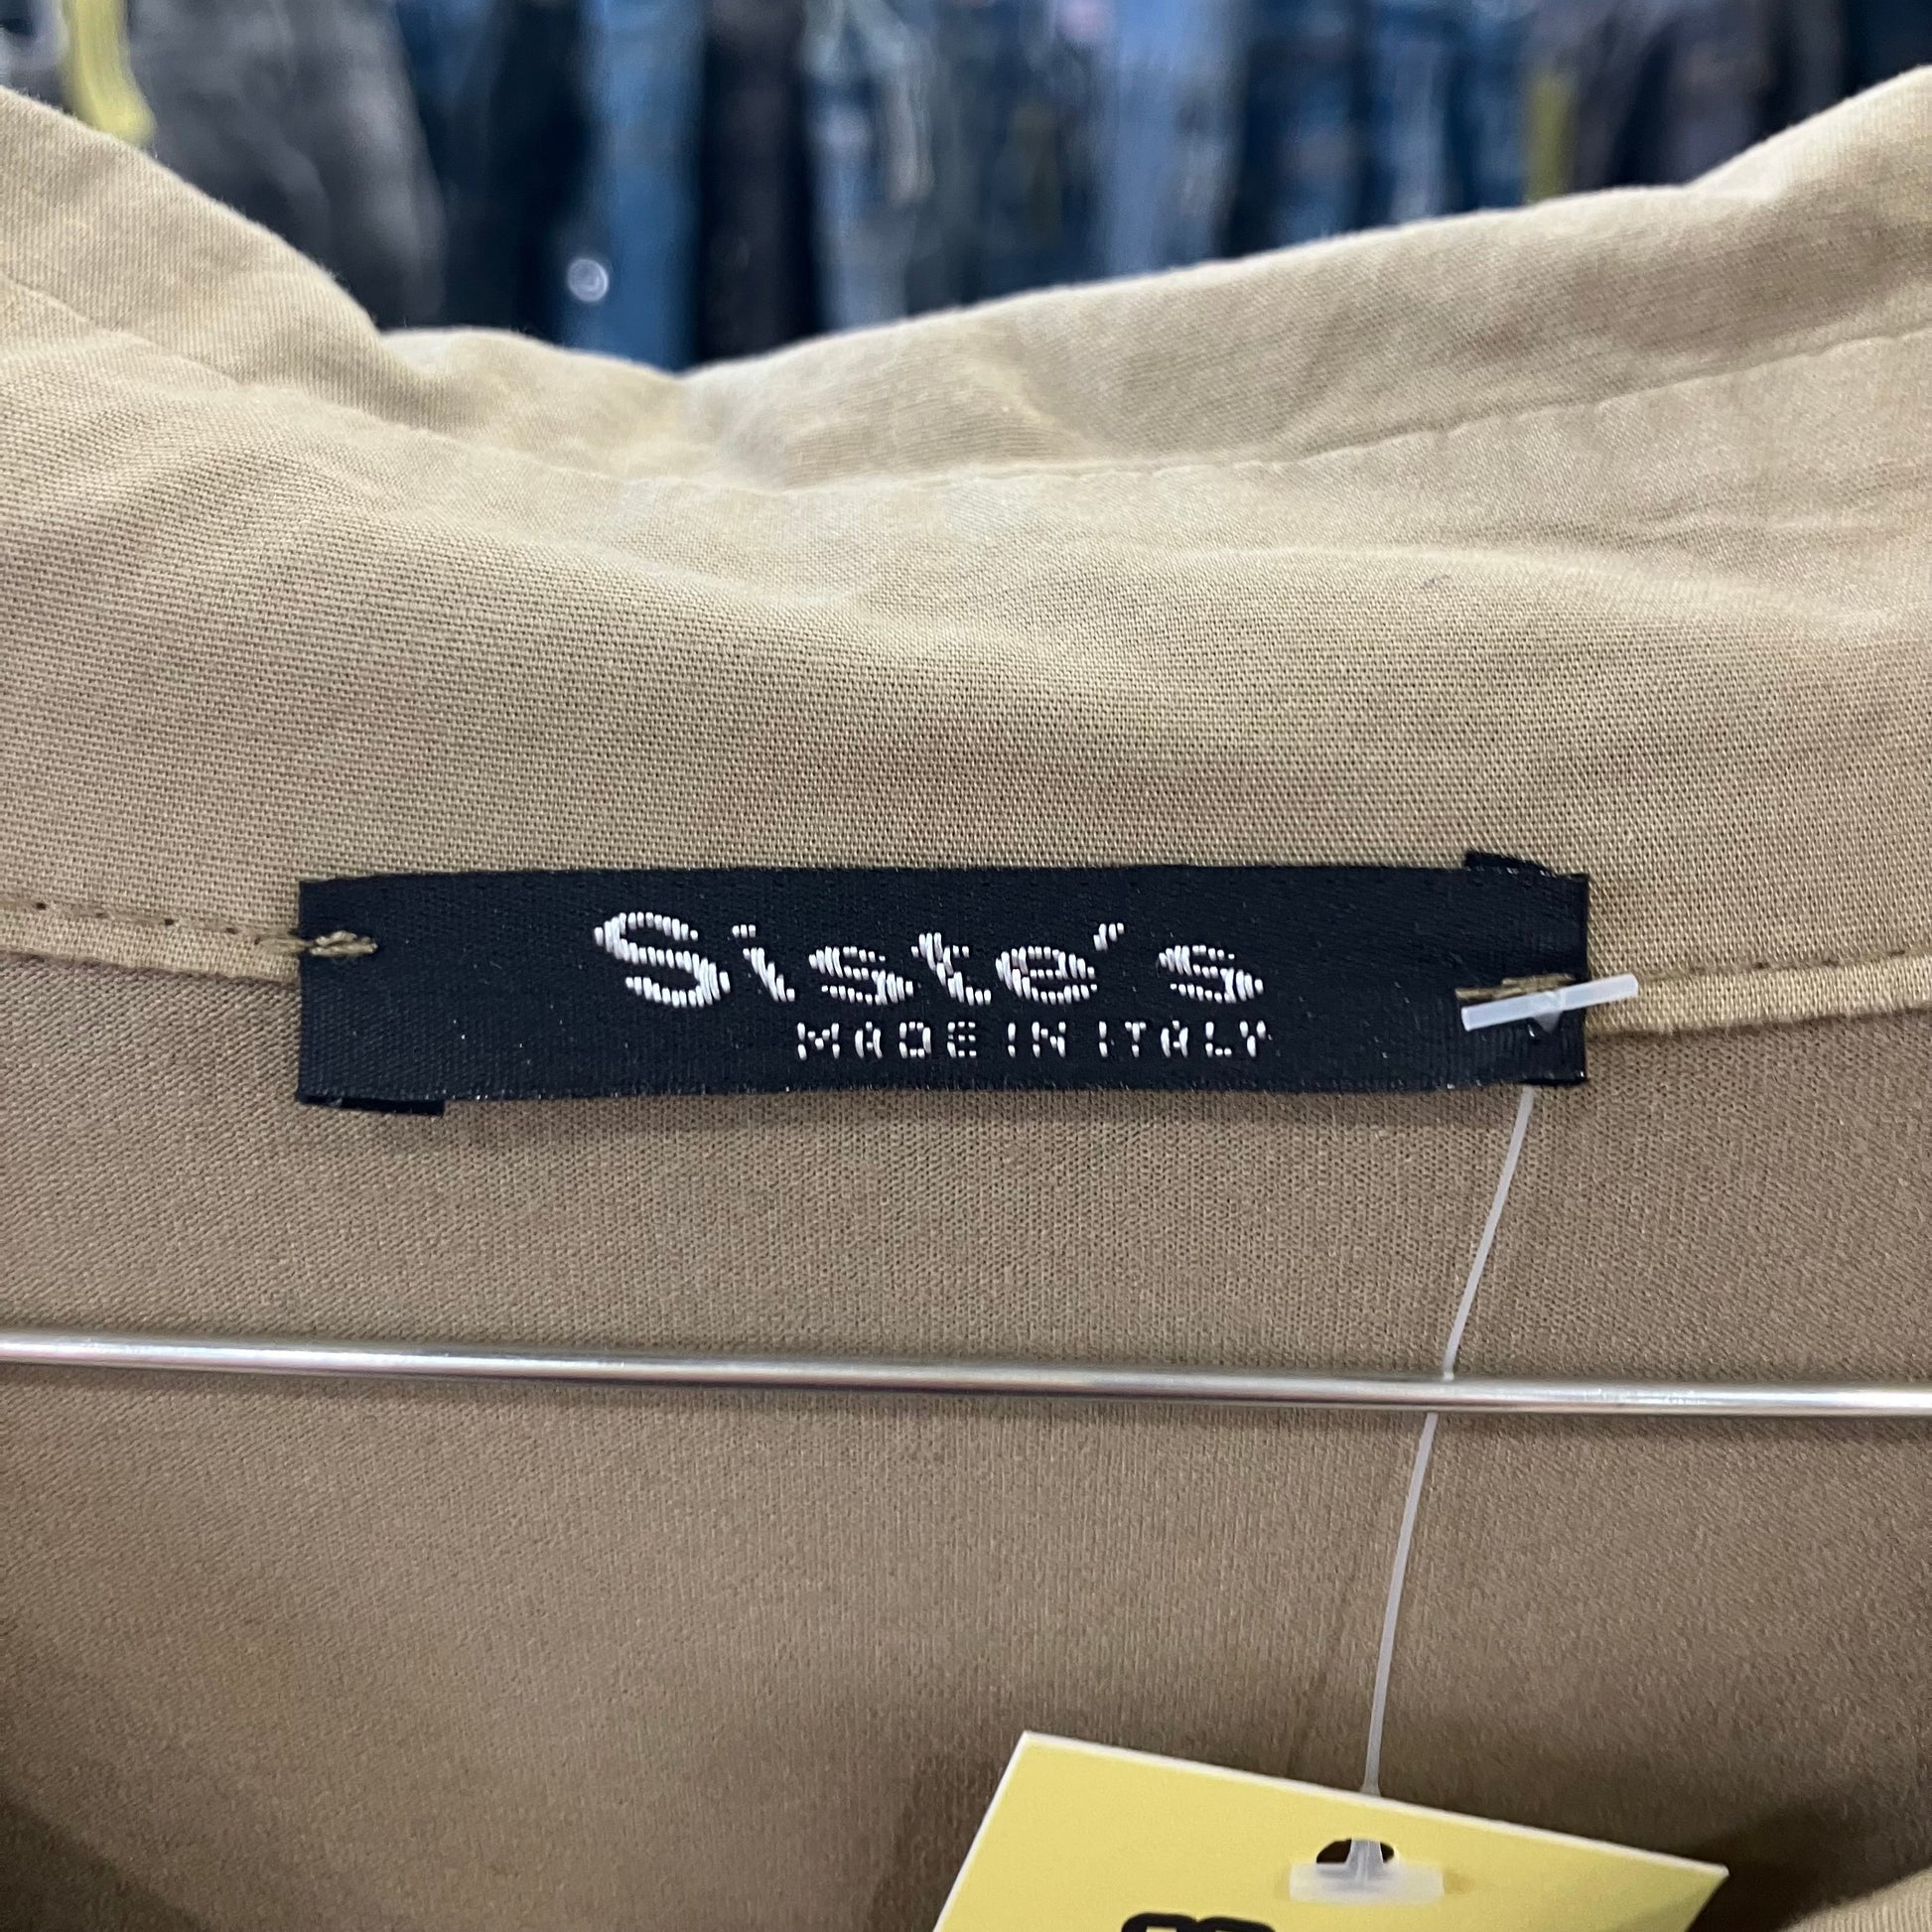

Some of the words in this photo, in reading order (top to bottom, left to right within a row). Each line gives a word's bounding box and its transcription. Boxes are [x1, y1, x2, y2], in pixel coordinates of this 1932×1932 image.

[594, 910, 1265, 1009] Siste's
[797, 1022, 978, 1059] MADE
[1007, 1021, 1067, 1059] IN
[1098, 1020, 1273, 1058] ITALY
